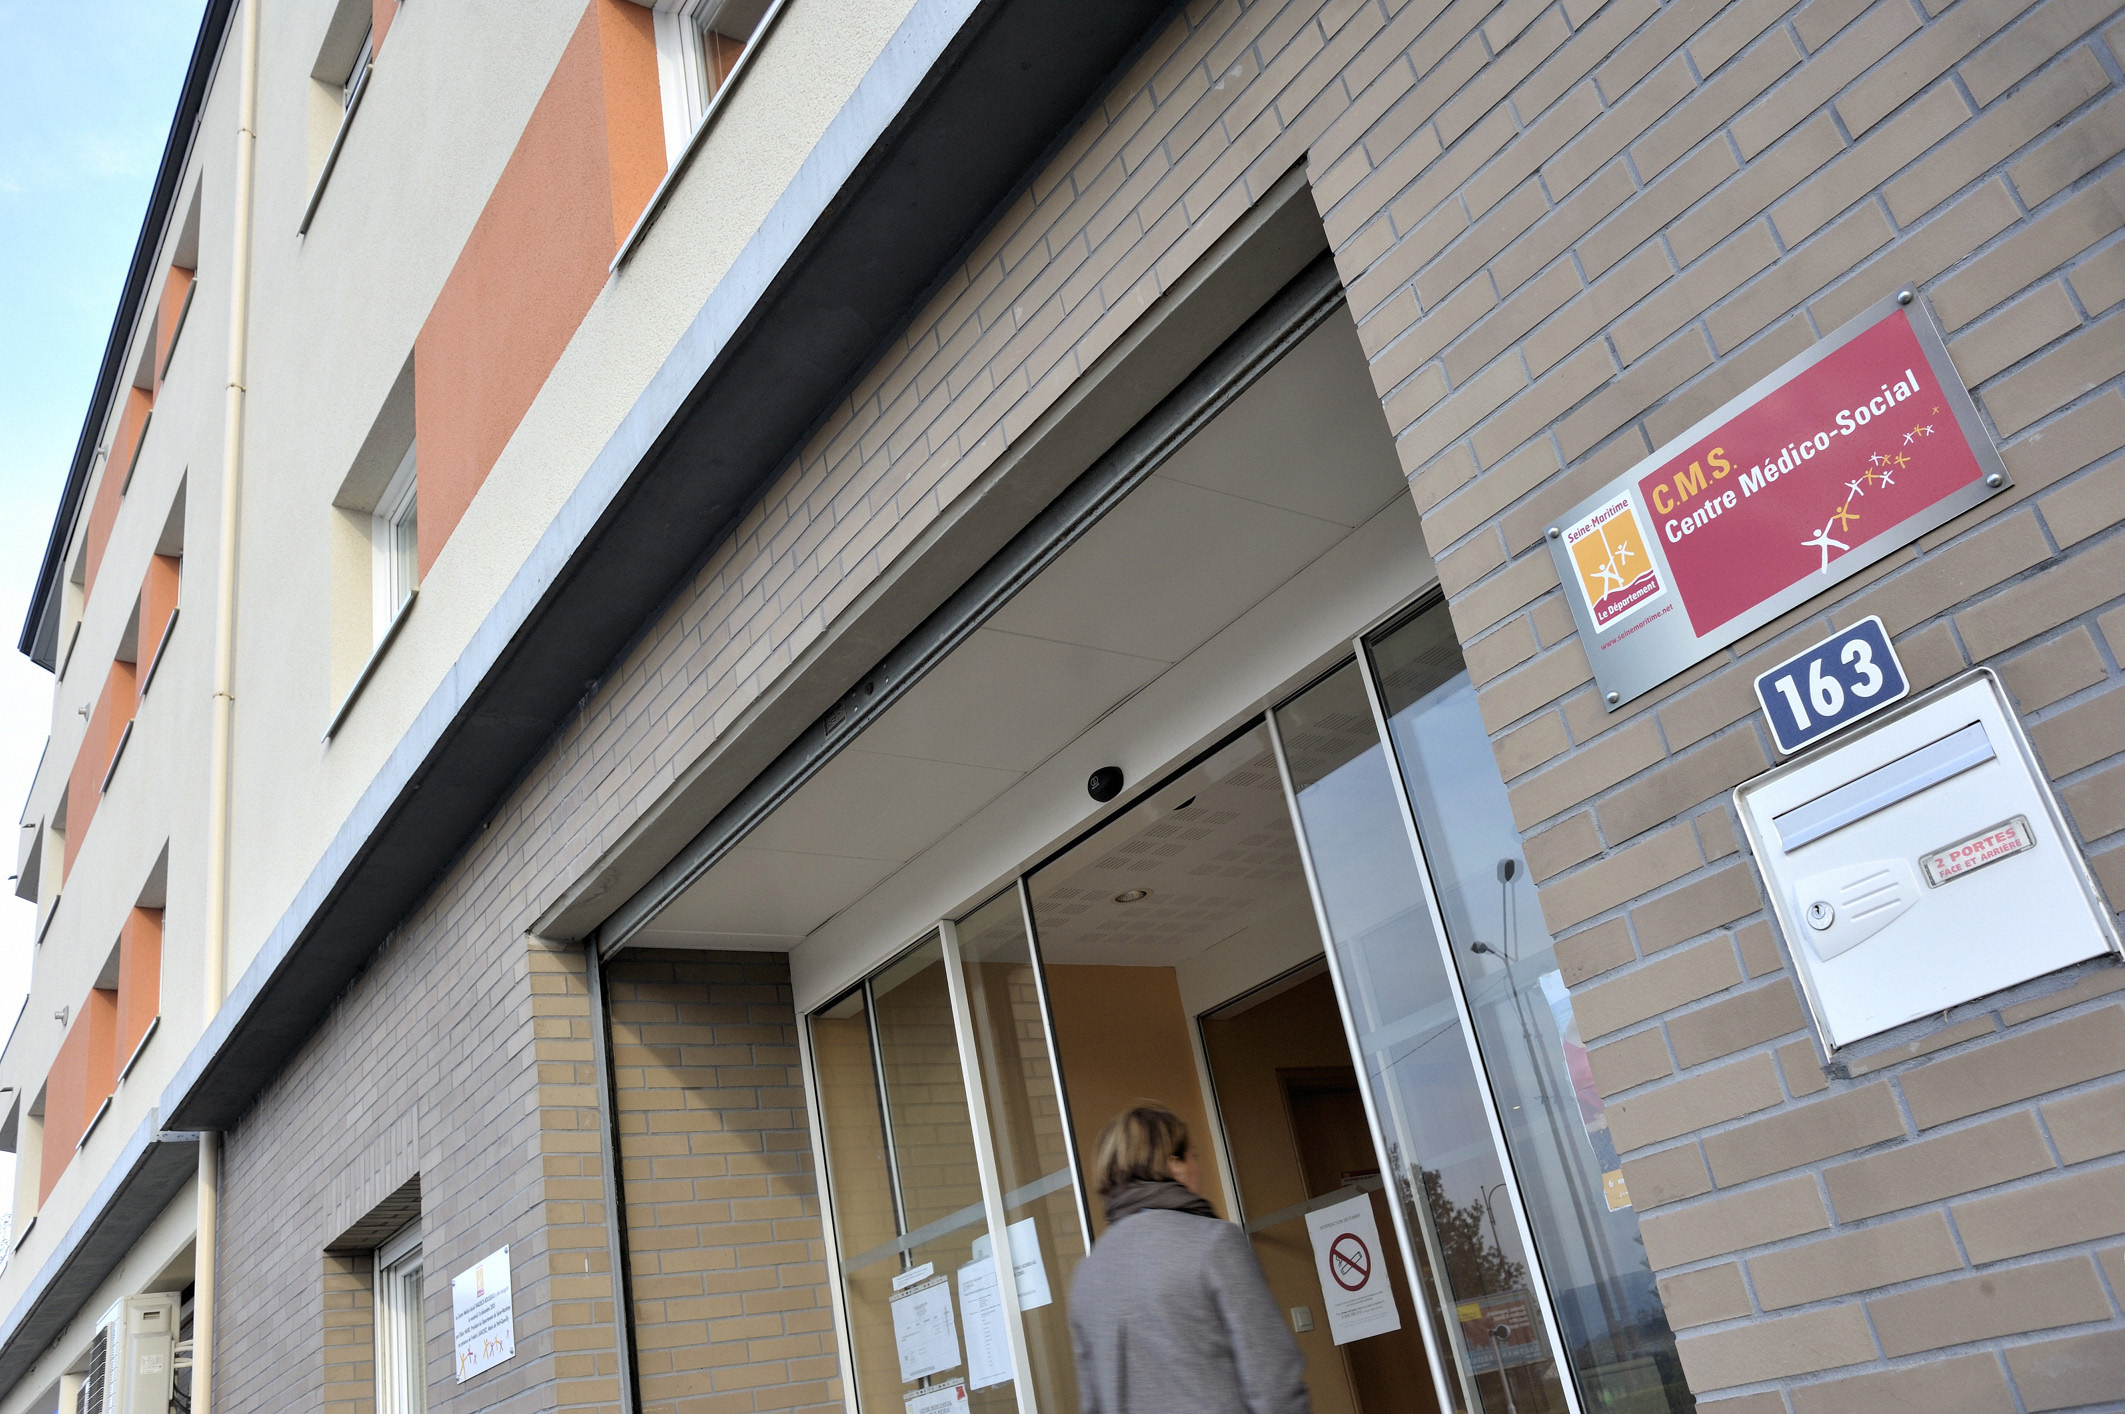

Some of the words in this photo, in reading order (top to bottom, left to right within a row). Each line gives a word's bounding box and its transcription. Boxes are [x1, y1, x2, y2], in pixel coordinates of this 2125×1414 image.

[1665, 490, 1737, 543] Centre
[1738, 368, 1920, 498] Médico-Social
[1652, 447, 1737, 515] C.M.S.
[1568, 499, 1628, 543] Seine-Maritime
[1597, 611, 1608, 621] Le
[1608, 581, 1656, 614] Département
[1601, 604, 1673, 650] www.seinemaritime.net
[1774, 638, 1883, 731] 163
[1935, 858, 1945, 869] 2
[1949, 827, 2016, 862] PORTES
[1939, 864, 1962, 878] FACE
[1965, 857, 1977, 868] ET
[1981, 839, 2022, 861] ARRIÈRE
